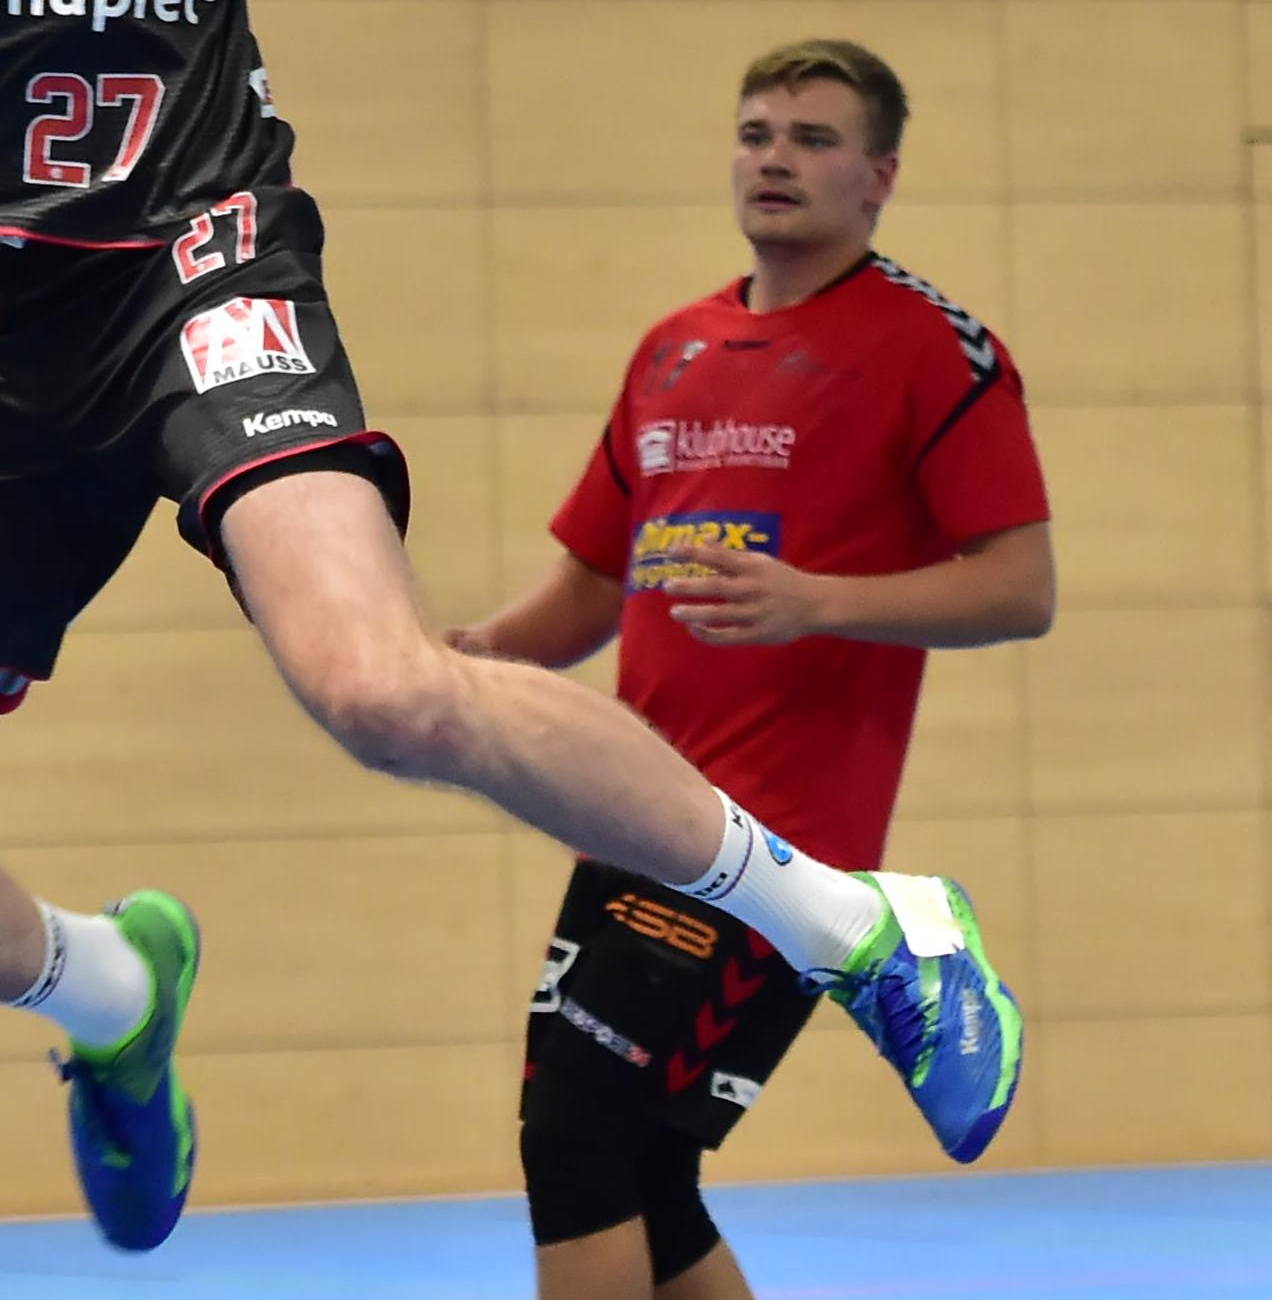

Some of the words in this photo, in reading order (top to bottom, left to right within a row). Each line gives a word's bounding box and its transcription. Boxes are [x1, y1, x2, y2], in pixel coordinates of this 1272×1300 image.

[23, 72, 165, 188] 27
[172, 191, 257, 285] 27
[213, 353, 308, 383] MAUSS
[242, 409, 338, 438] Kempa
